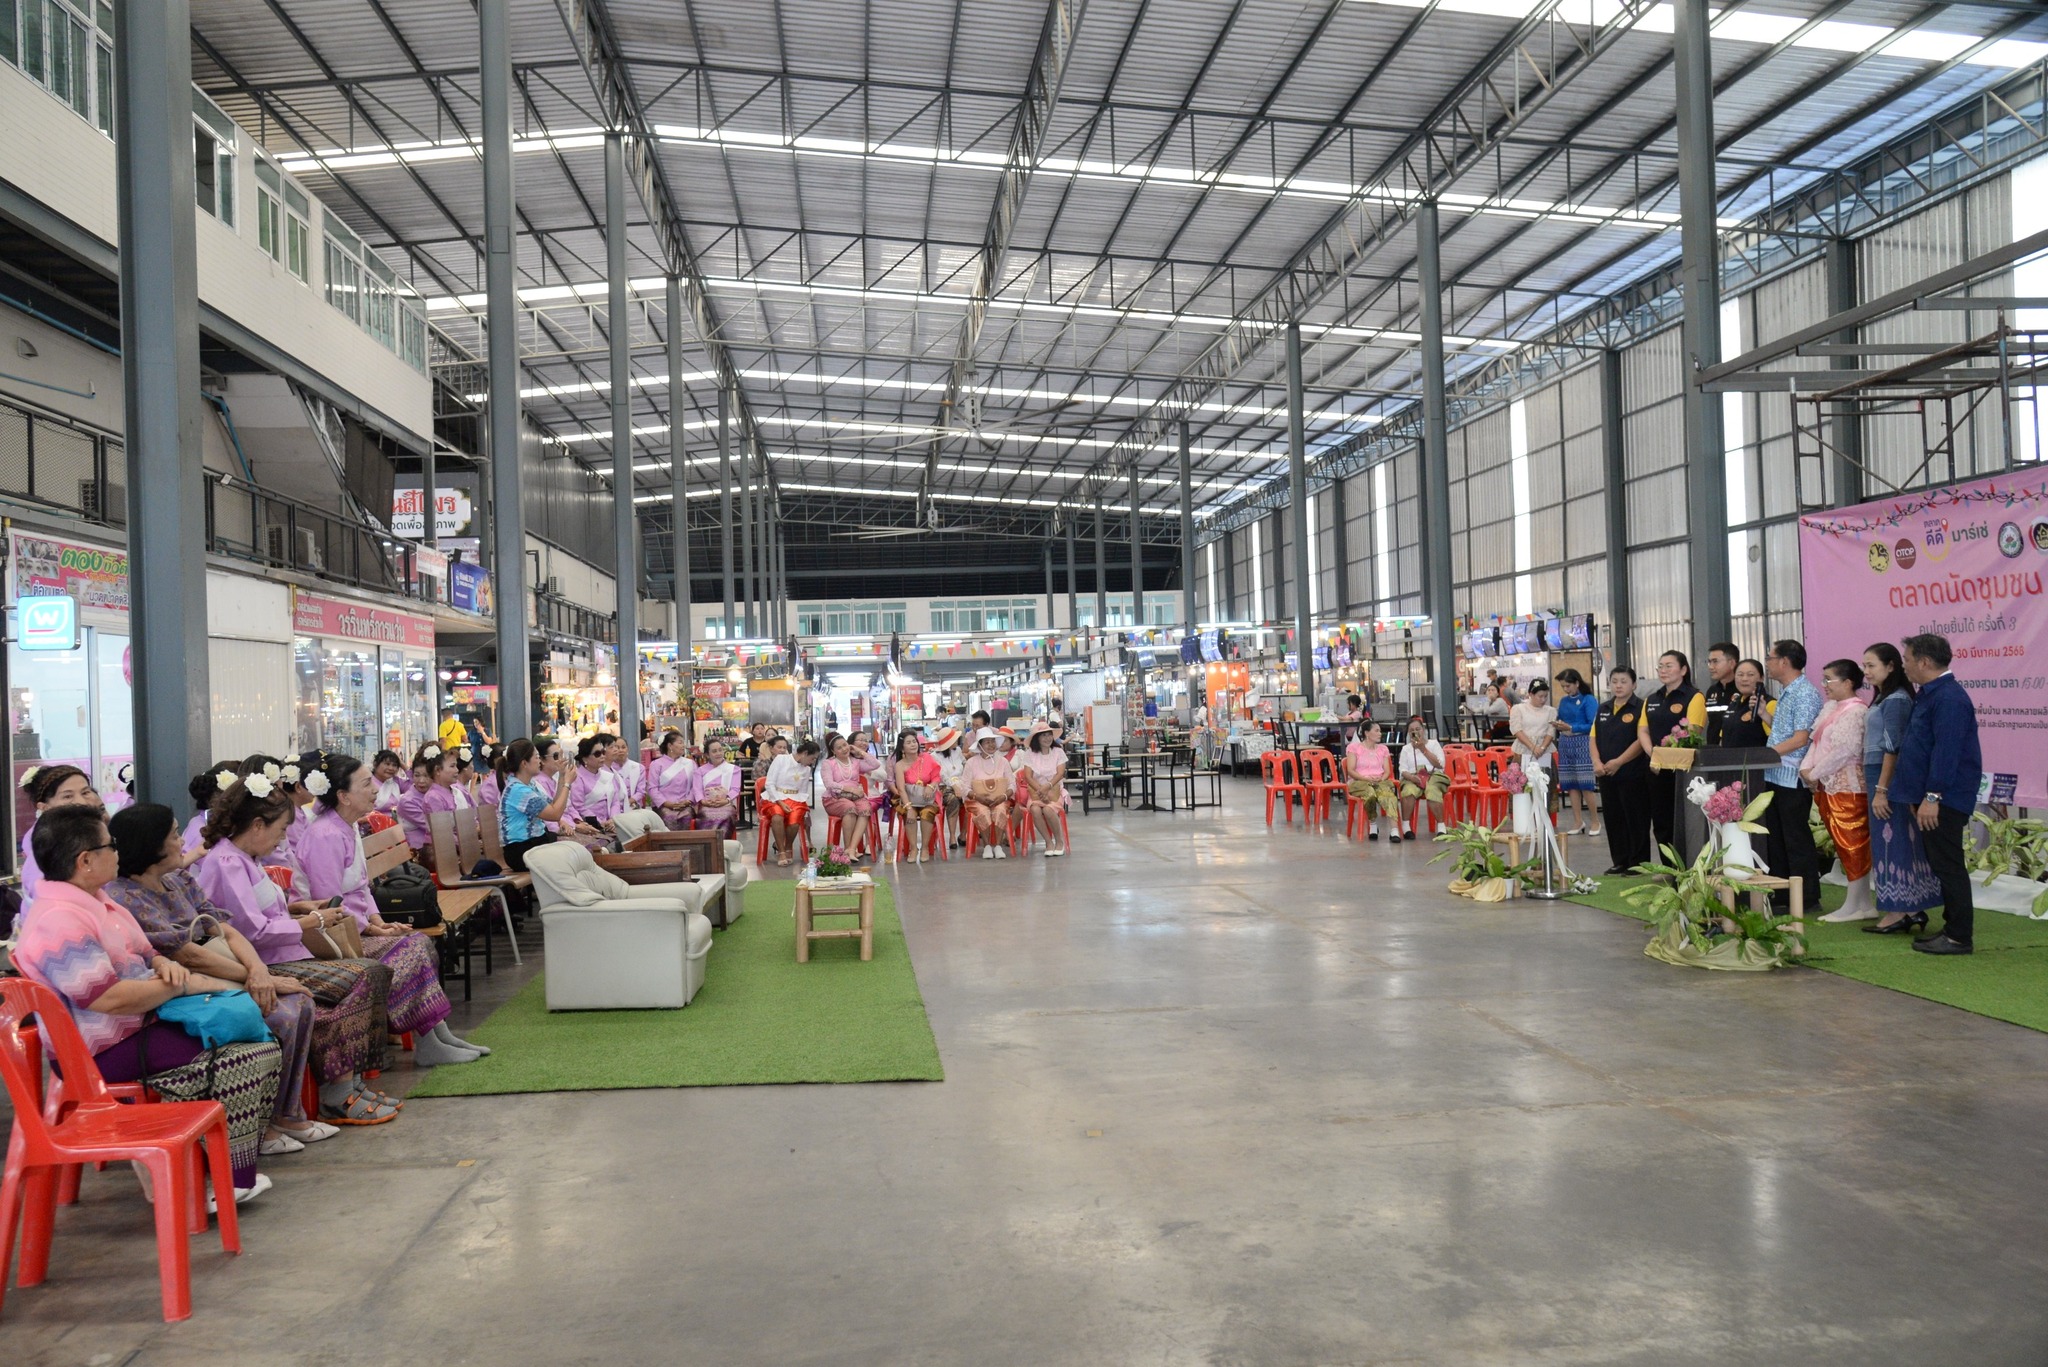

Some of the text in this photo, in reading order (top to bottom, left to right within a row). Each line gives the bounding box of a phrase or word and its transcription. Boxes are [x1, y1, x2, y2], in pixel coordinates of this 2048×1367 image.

[1895, 547, 1915, 558] OTOP
[1889, 571, 2043, 609] ตลาดนัดชุมชน
[1970, 646, 2000, 659] มีนาคม
[2002, 646, 2025, 657] 2568
